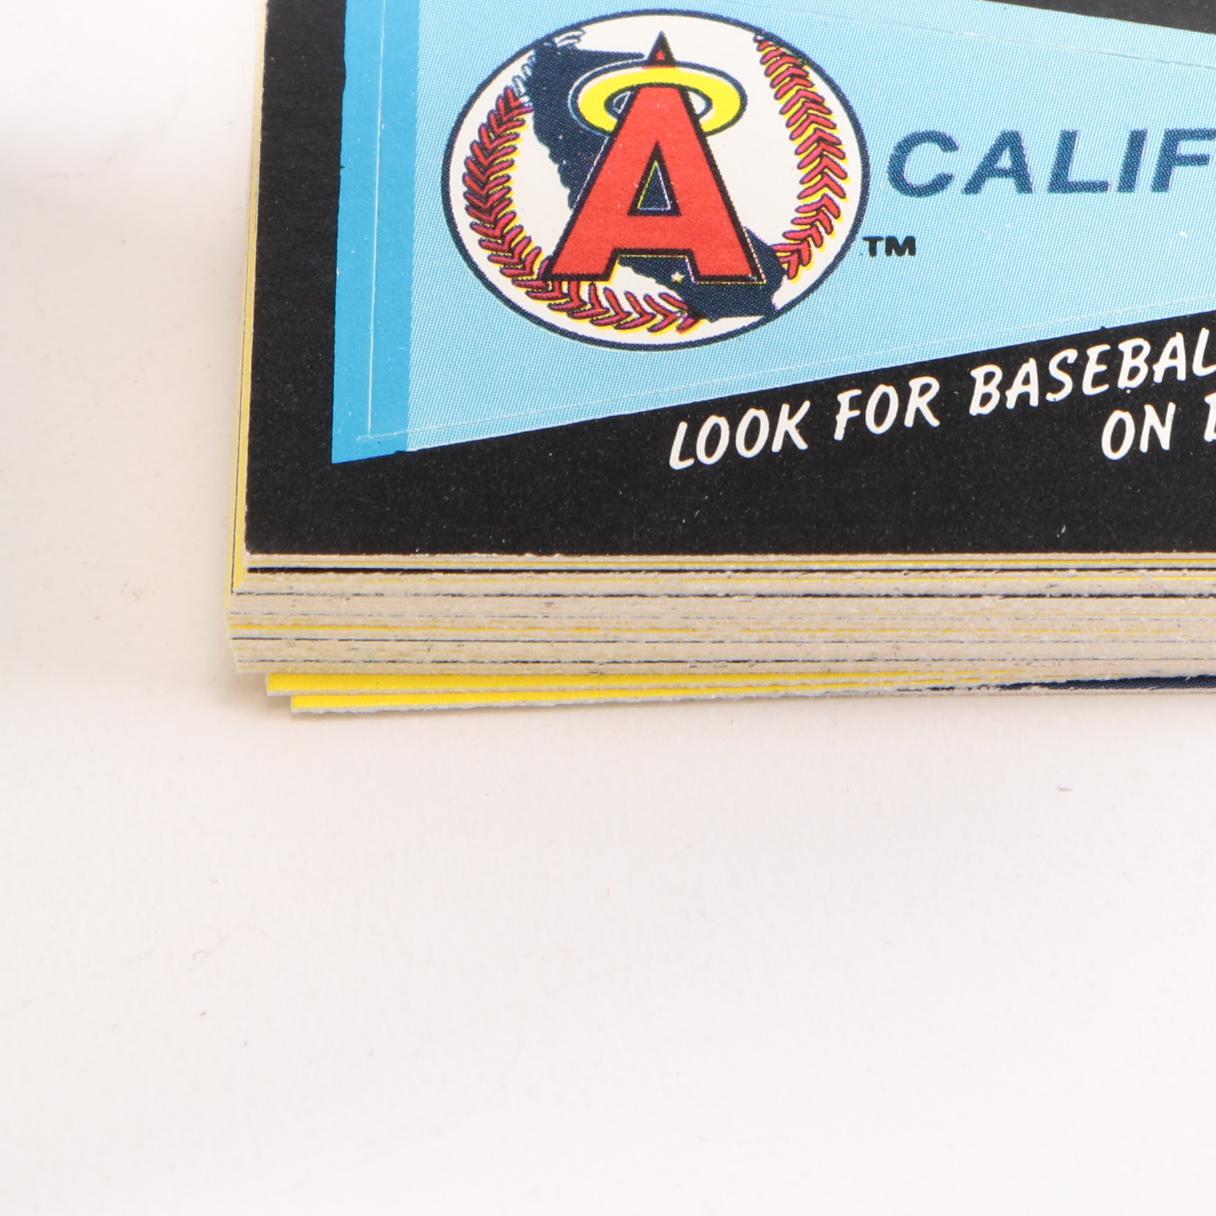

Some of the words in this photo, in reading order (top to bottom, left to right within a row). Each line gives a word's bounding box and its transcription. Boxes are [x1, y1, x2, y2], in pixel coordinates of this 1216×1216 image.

[862, 235, 917, 257] TM
[669, 400, 811, 470] LOOK
[834, 376, 940, 441] FOR
[1101, 402, 1176, 461] ON
